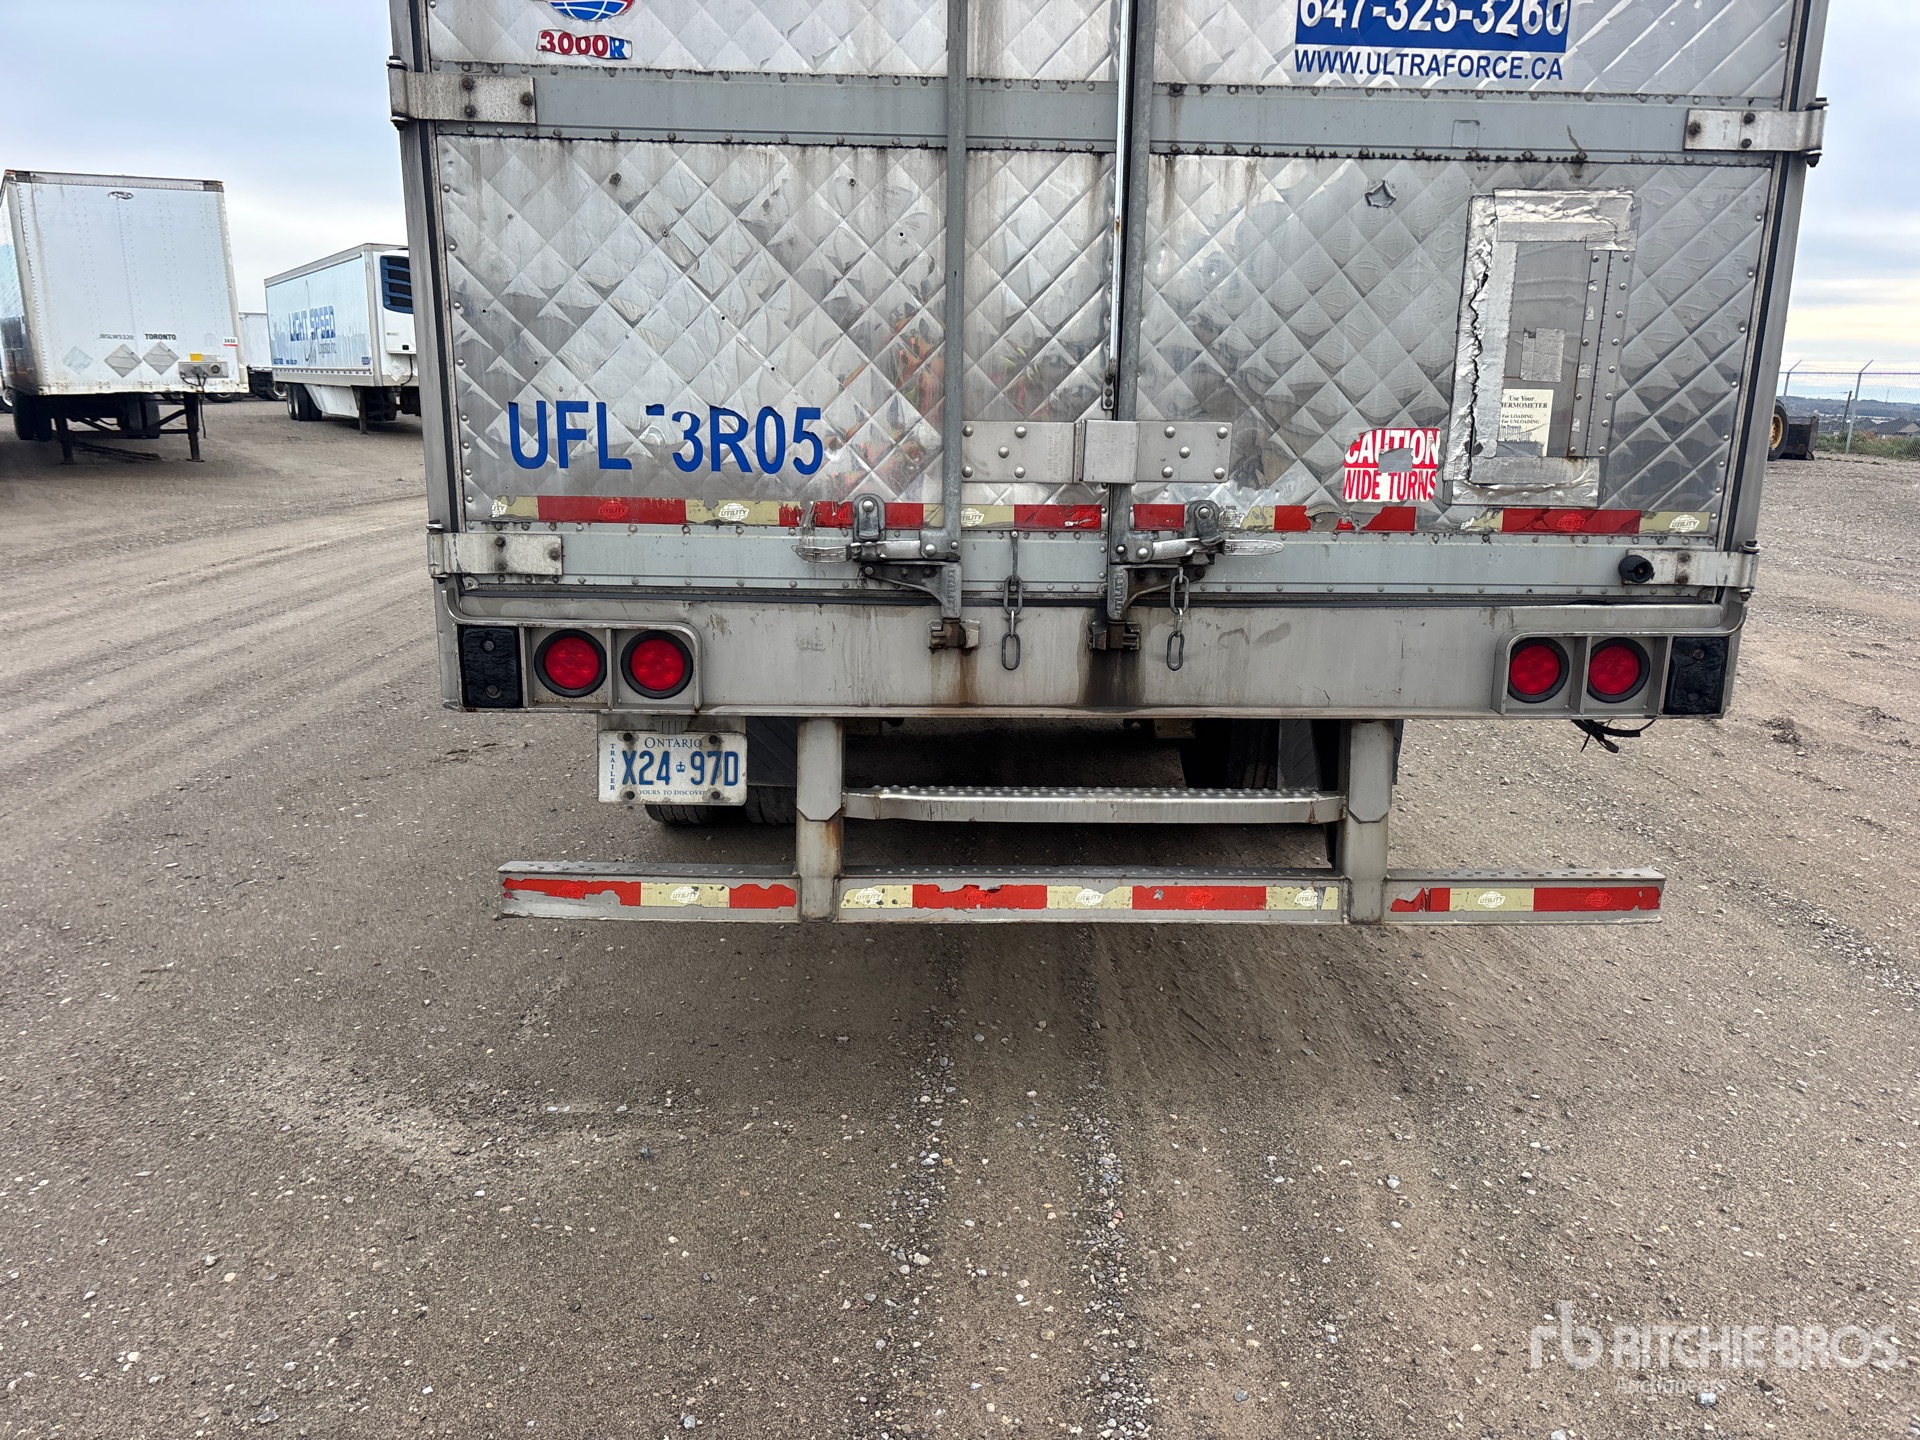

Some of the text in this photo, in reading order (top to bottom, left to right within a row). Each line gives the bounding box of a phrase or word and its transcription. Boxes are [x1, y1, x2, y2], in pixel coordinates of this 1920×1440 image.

[1300, 0, 1565, 36] 647-325-3260
[540, 31, 627, 59] 3000R
[1295, 50, 1563, 80] WWW.ULTRAFORCE.CA
[508, 401, 823, 476] UFL3R05
[1343, 469, 1436, 500] WIDE TURNS
[622, 750, 739, 786] X24 97D
